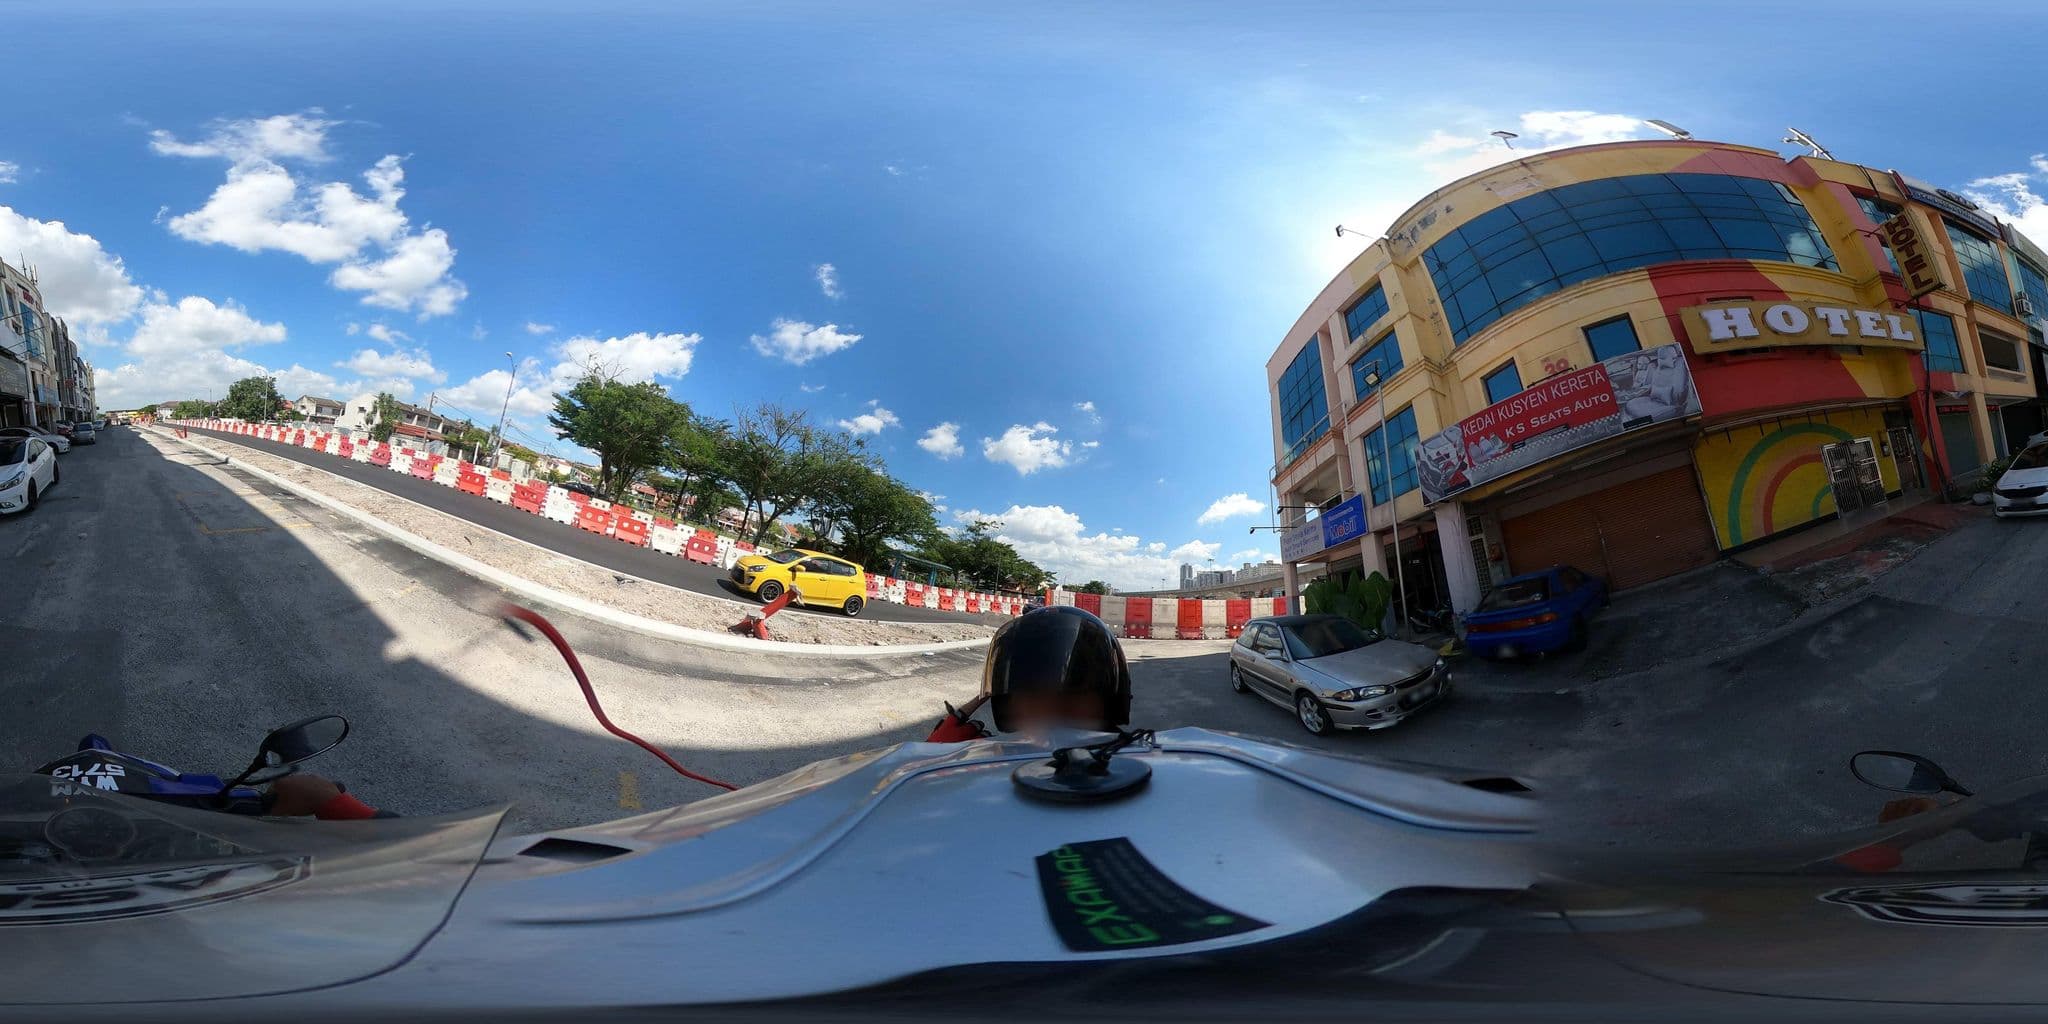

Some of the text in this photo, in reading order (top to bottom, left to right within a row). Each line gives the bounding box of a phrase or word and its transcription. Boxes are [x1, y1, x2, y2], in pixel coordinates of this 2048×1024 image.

[1884, 213, 1934, 291] HOTEL
[1699, 303, 1915, 343] HOTEL
[1462, 369, 1606, 438] KEDAI KUSYEN KERETA
[1531, 406, 1572, 429] SEATS
[1574, 392, 1611, 413] AUTO
[1329, 519, 1357, 539] Mobil
[53, 763, 126, 779] 5713
